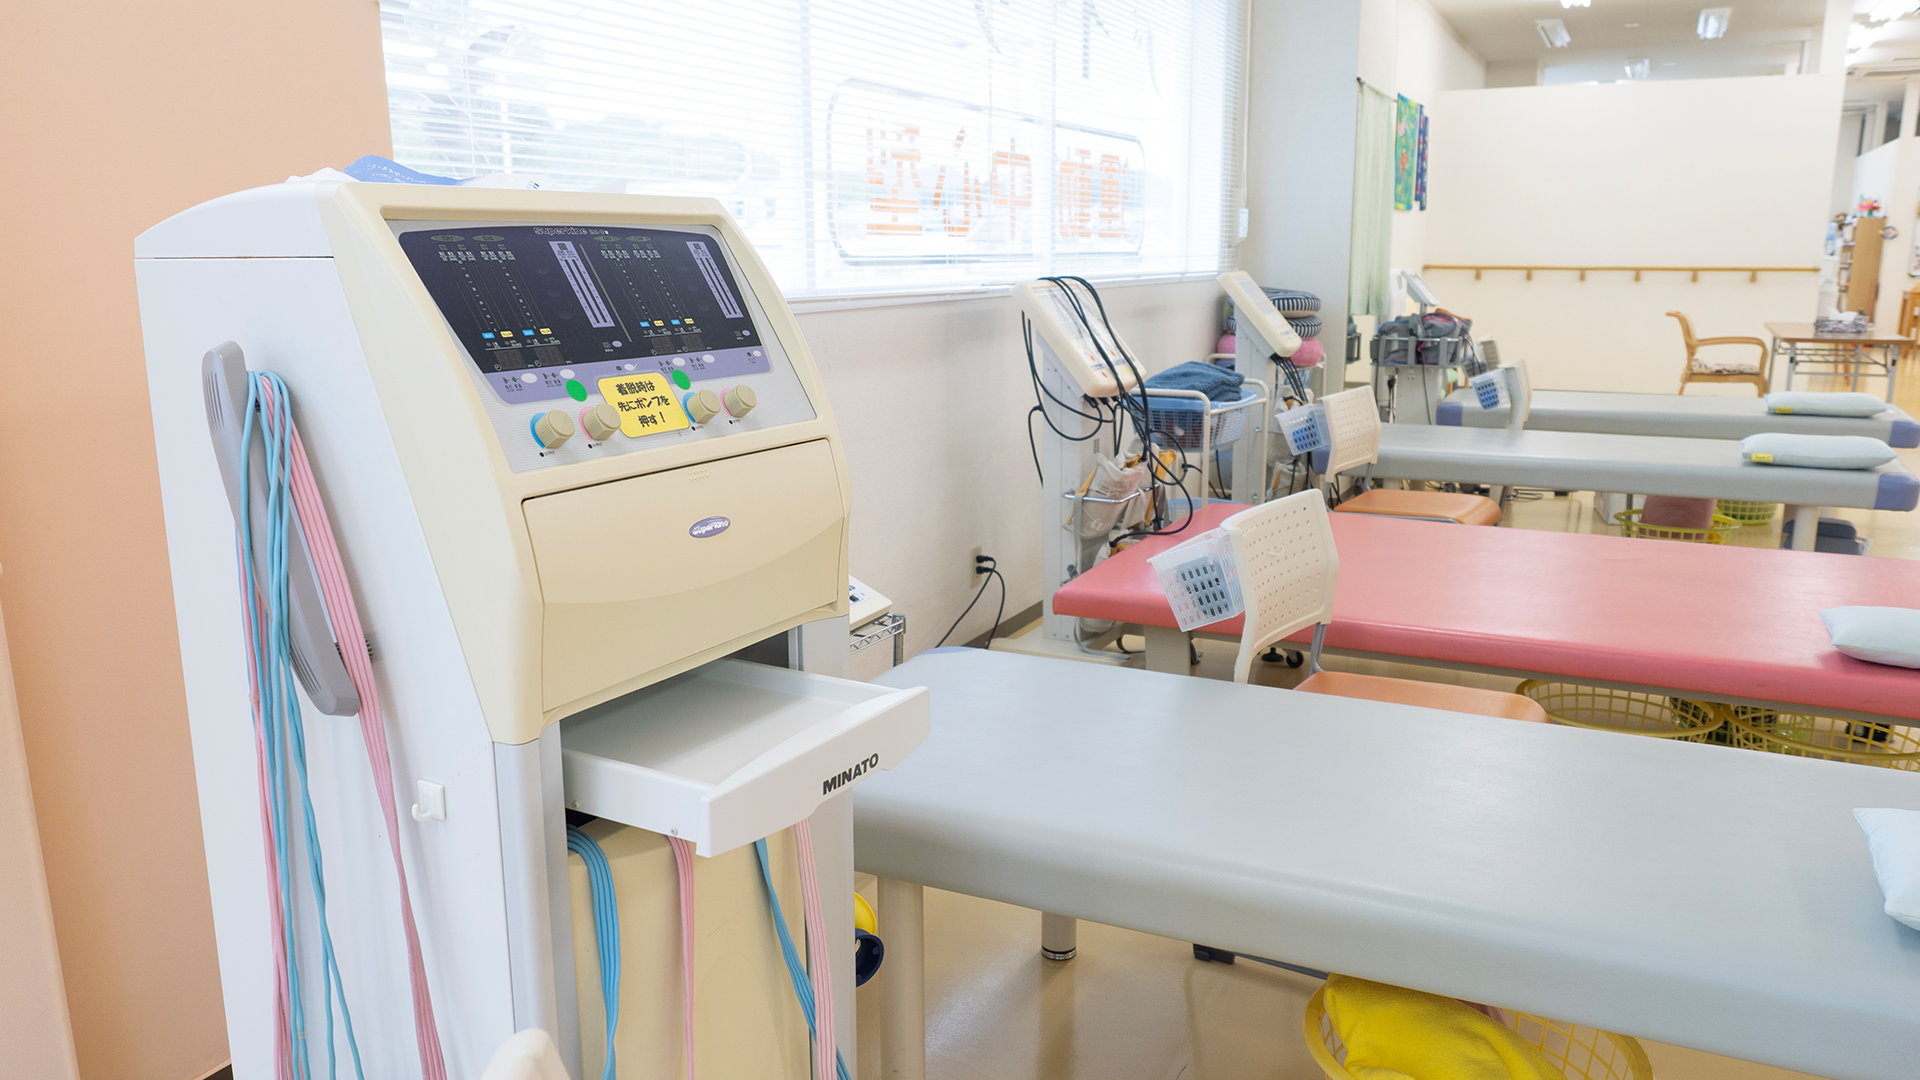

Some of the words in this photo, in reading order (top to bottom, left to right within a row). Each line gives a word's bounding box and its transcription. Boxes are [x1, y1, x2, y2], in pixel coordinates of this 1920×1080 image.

[615, 380, 655, 395] 着脱時は
[823, 752, 879, 796] MINATO
